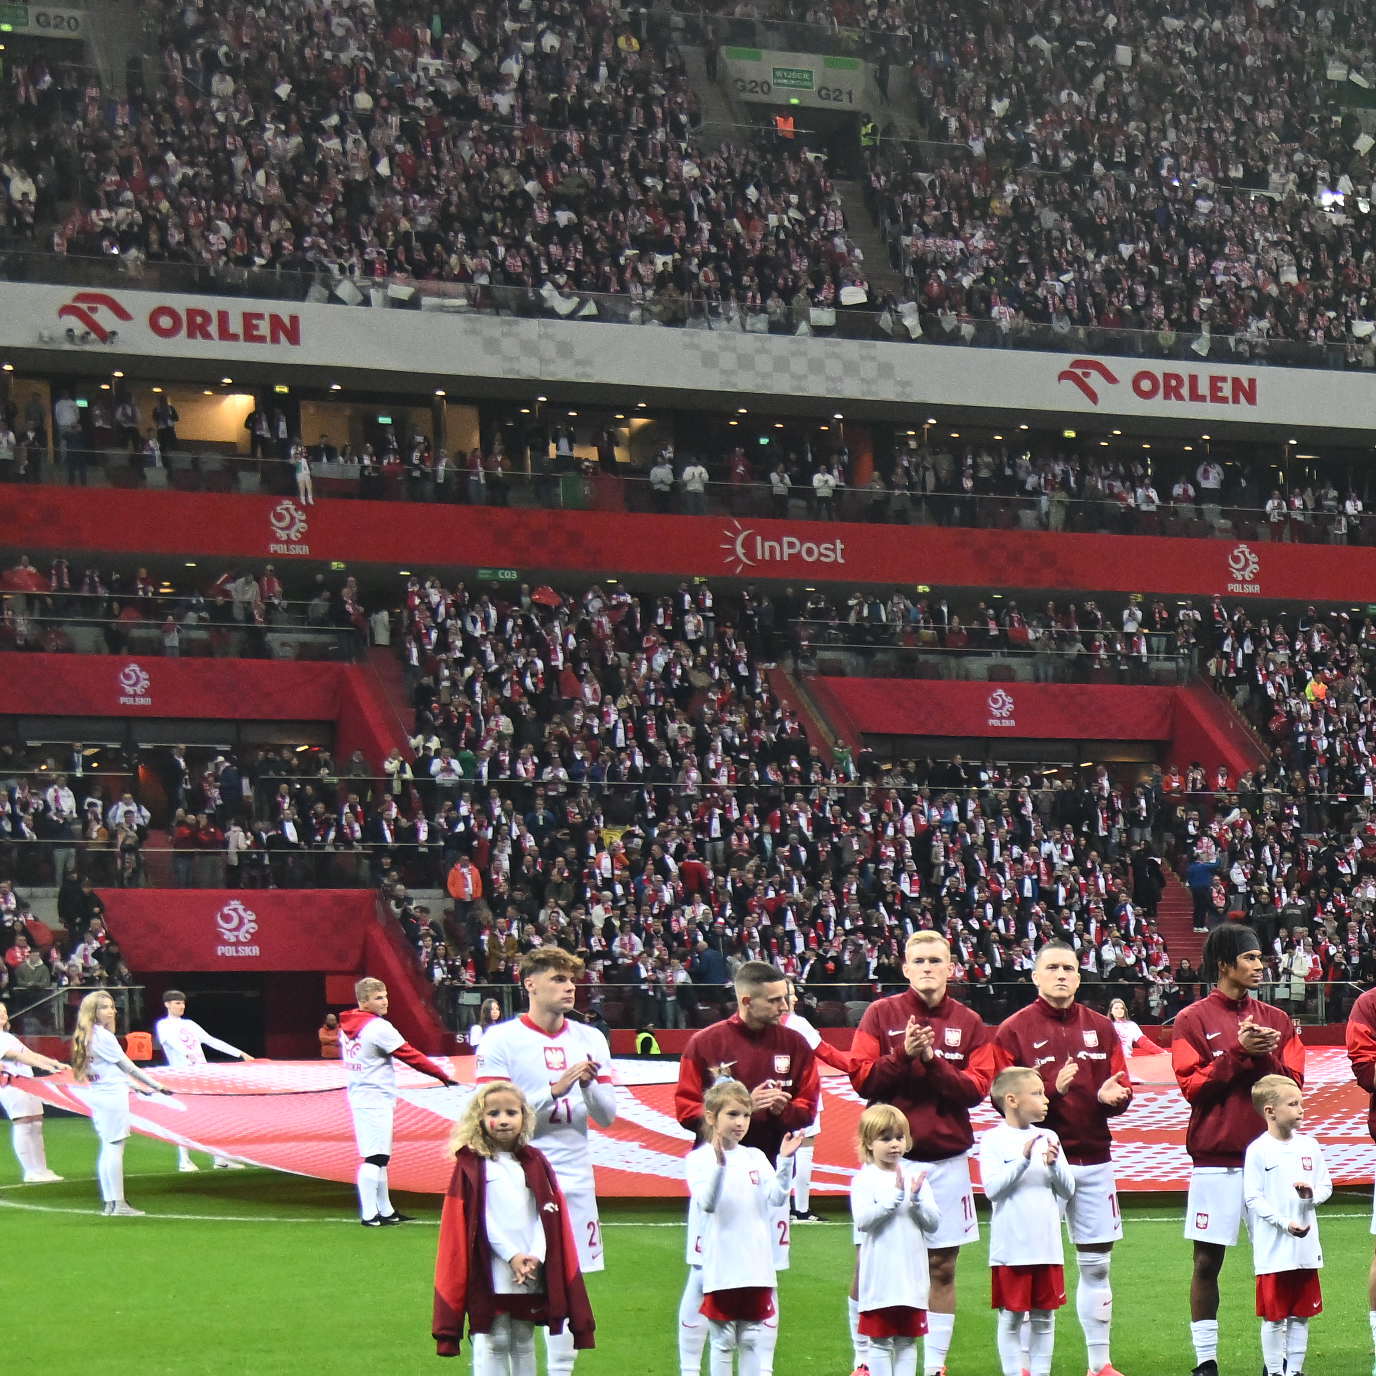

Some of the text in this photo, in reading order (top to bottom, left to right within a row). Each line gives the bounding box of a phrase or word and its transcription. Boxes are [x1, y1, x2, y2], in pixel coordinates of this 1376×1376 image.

[36, 12, 80, 33] G20
[735, 79, 771, 95] G20
[817, 86, 855, 104] G21
[148, 304, 302, 347] ORLEN
[1131, 369, 1259, 408] ORLEN
[270, 543, 310, 555] POLSKA
[757, 534, 846, 565] InPost
[498, 569, 518, 580] C03
[1227, 583, 1261, 595] POLSKA
[119, 696, 152, 706] POLSKA
[988, 718, 1016, 728] POLSKA
[217, 944, 260, 957] POLSKA
[549, 1098, 573, 1124] 21
[961, 1194, 973, 1221] 11
[1108, 1193, 1119, 1218] 1
